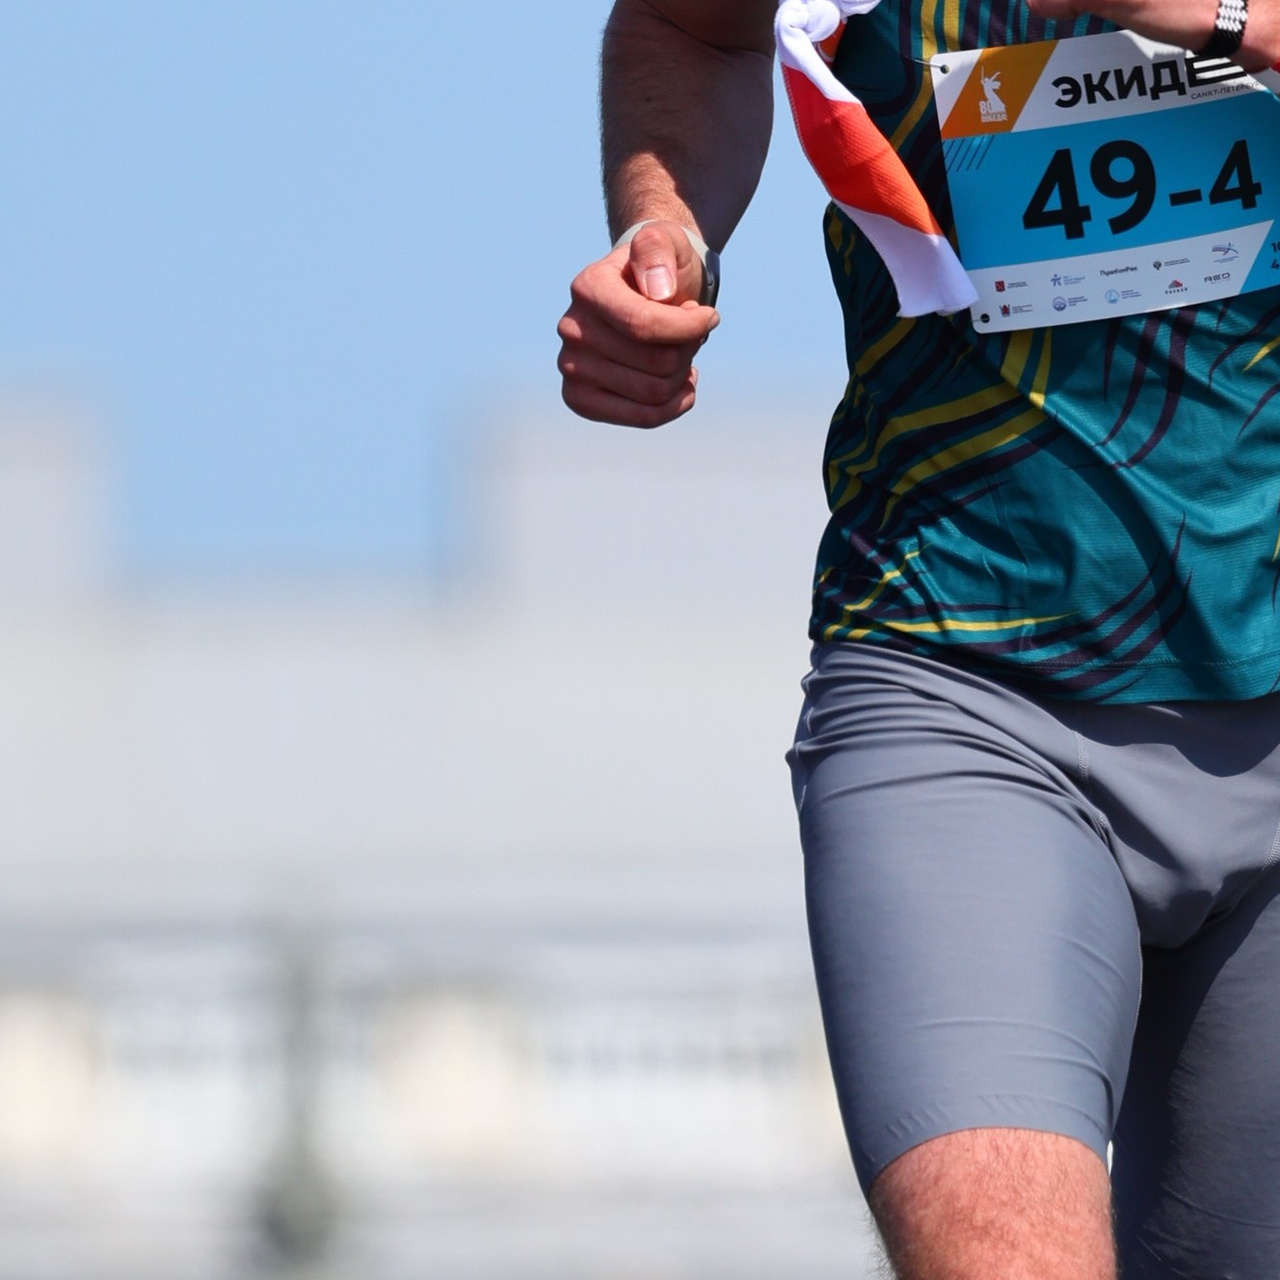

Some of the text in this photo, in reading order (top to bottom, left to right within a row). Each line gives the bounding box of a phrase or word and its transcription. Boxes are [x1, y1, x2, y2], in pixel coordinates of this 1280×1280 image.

[1052, 56, 1247, 108] ЭКИДЕ
[1022, 139, 1262, 240] 49-4
[1271, 260, 1280, 269] 4
